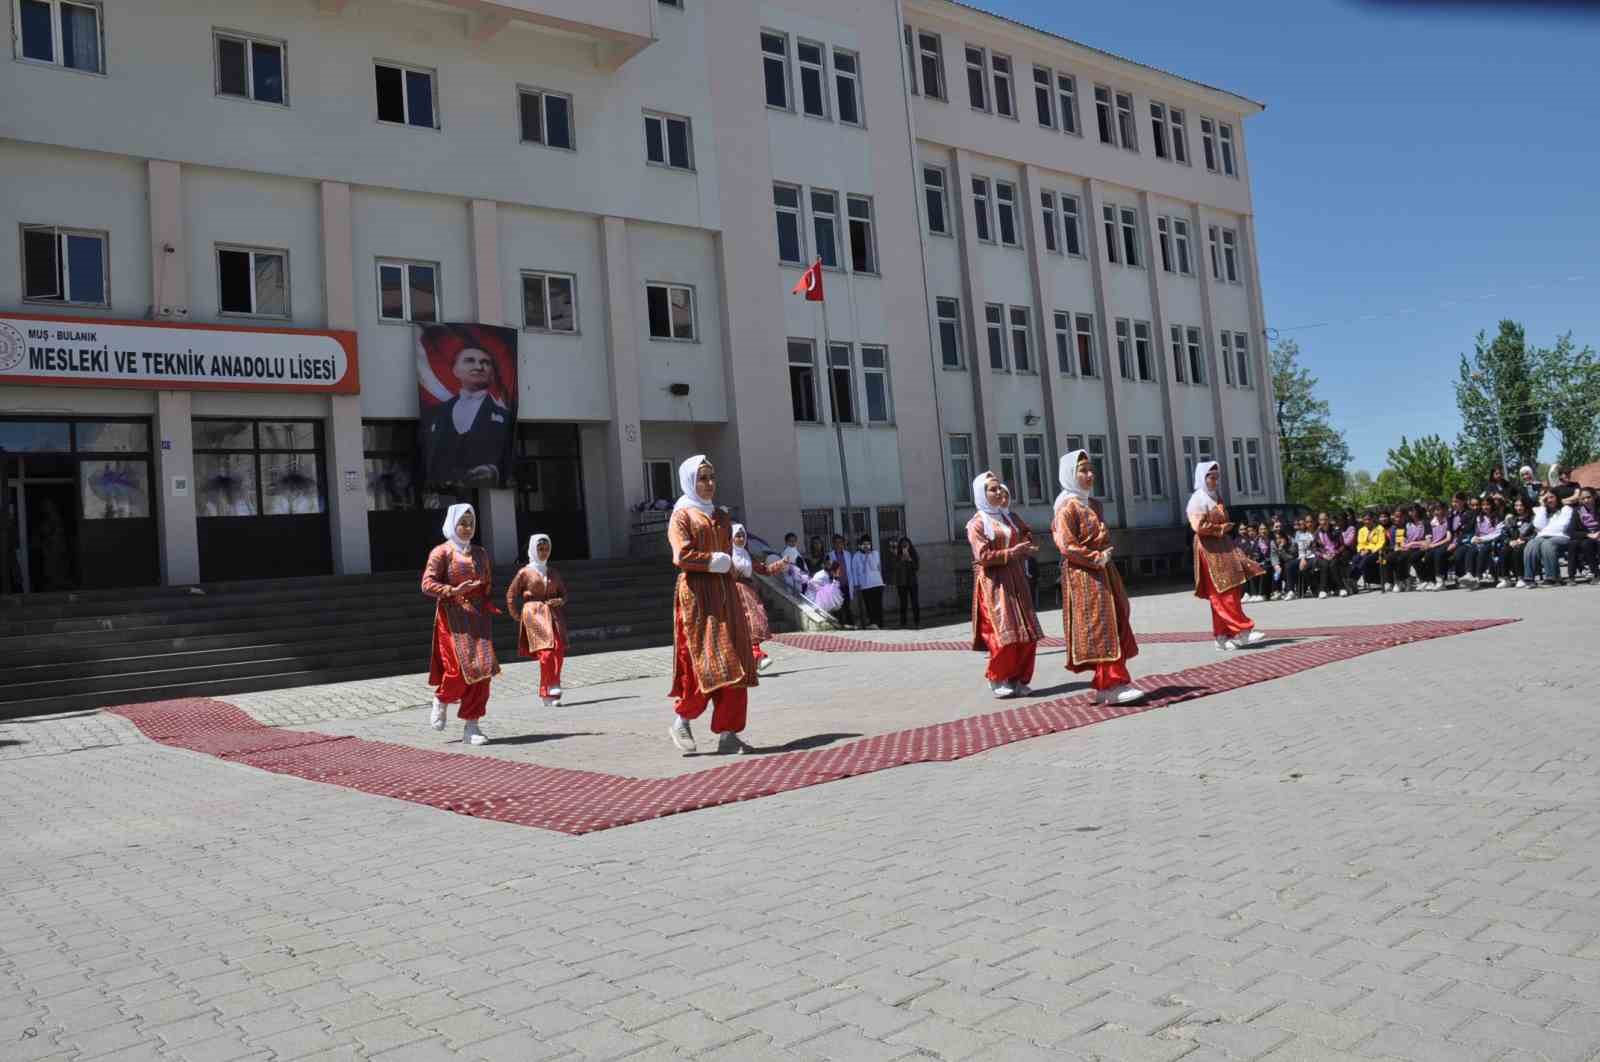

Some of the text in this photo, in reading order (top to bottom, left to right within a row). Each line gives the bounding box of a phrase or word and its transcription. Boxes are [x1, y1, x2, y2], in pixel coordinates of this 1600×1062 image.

[28, 329, 49, 342] MUŞ
[56, 330, 97, 342] BULANIK
[28, 345, 337, 380] MESLEKİ VE TEKNİK ANADOLU LİSESİ
